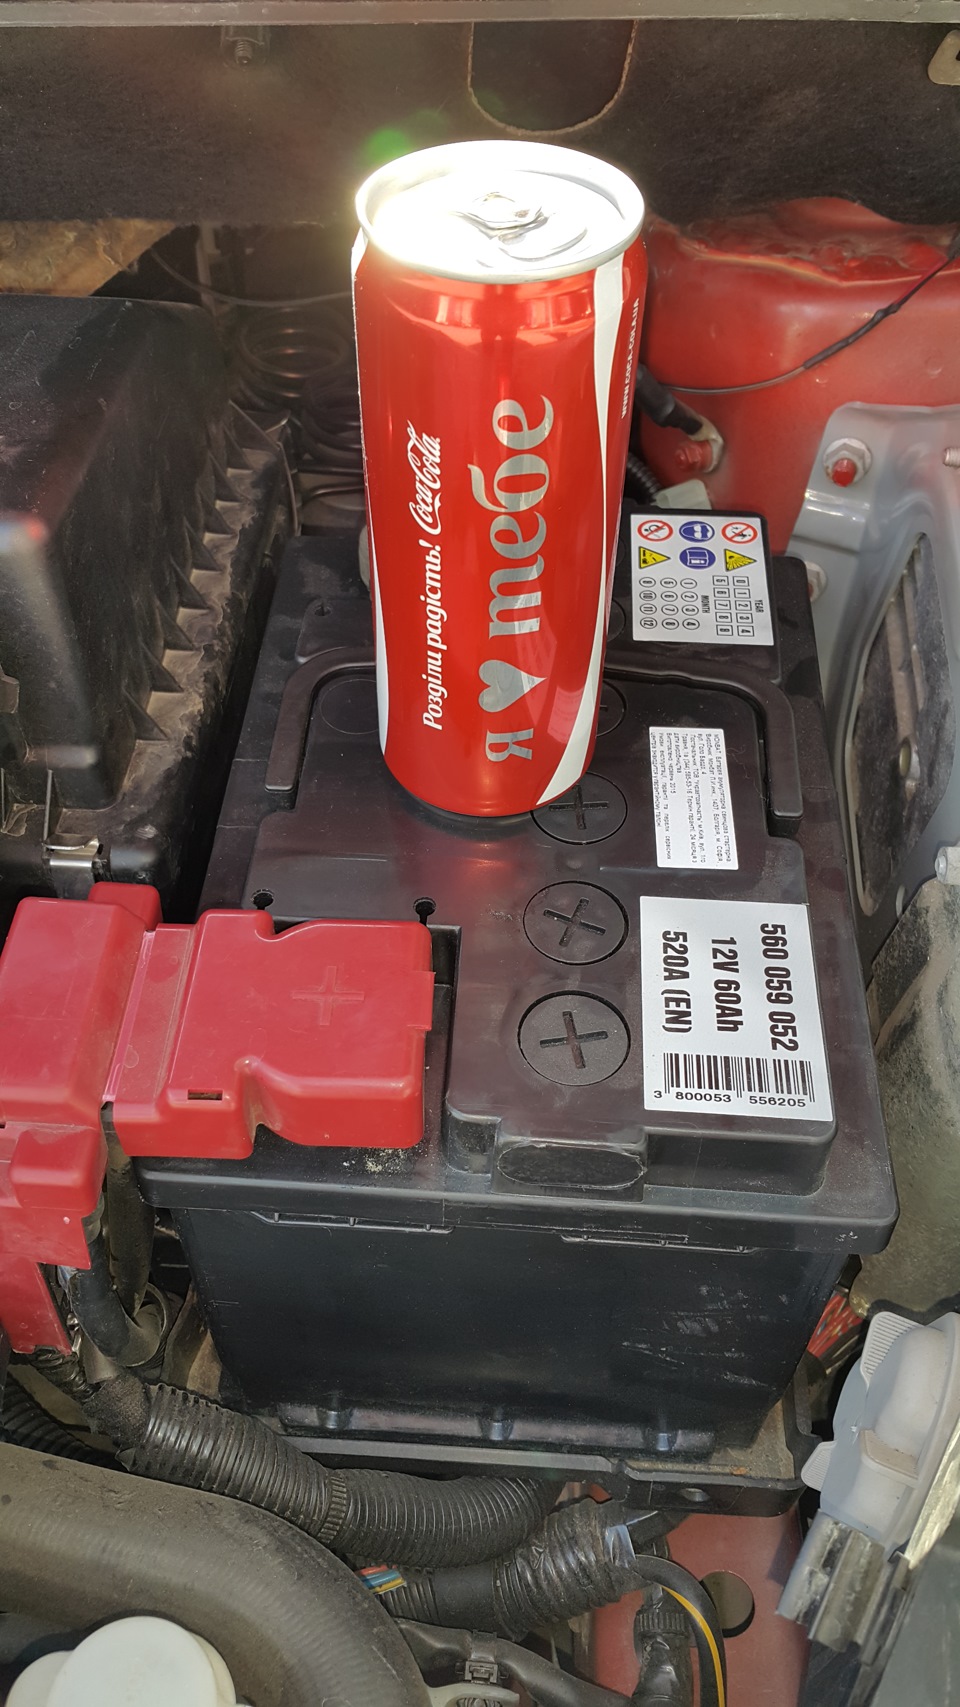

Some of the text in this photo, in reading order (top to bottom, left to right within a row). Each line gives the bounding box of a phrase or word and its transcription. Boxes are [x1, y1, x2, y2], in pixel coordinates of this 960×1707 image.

[621, 297, 640, 419] WWW.COCA-COLA.UA
[467, 394, 554, 640] тебе
[418, 538, 448, 731] Розділи радість!
[643, 619, 654, 627] 12
[701, 594, 711, 614] MONTH
[754, 599, 764, 613] YEAR
[660, 930, 692, 1034] 520A (EN)
[711, 936, 744, 1032] 12V 60Ah
[760, 923, 799, 1052] 560 059 052
[653, 1090, 807, 1108] 3 800053 556205
